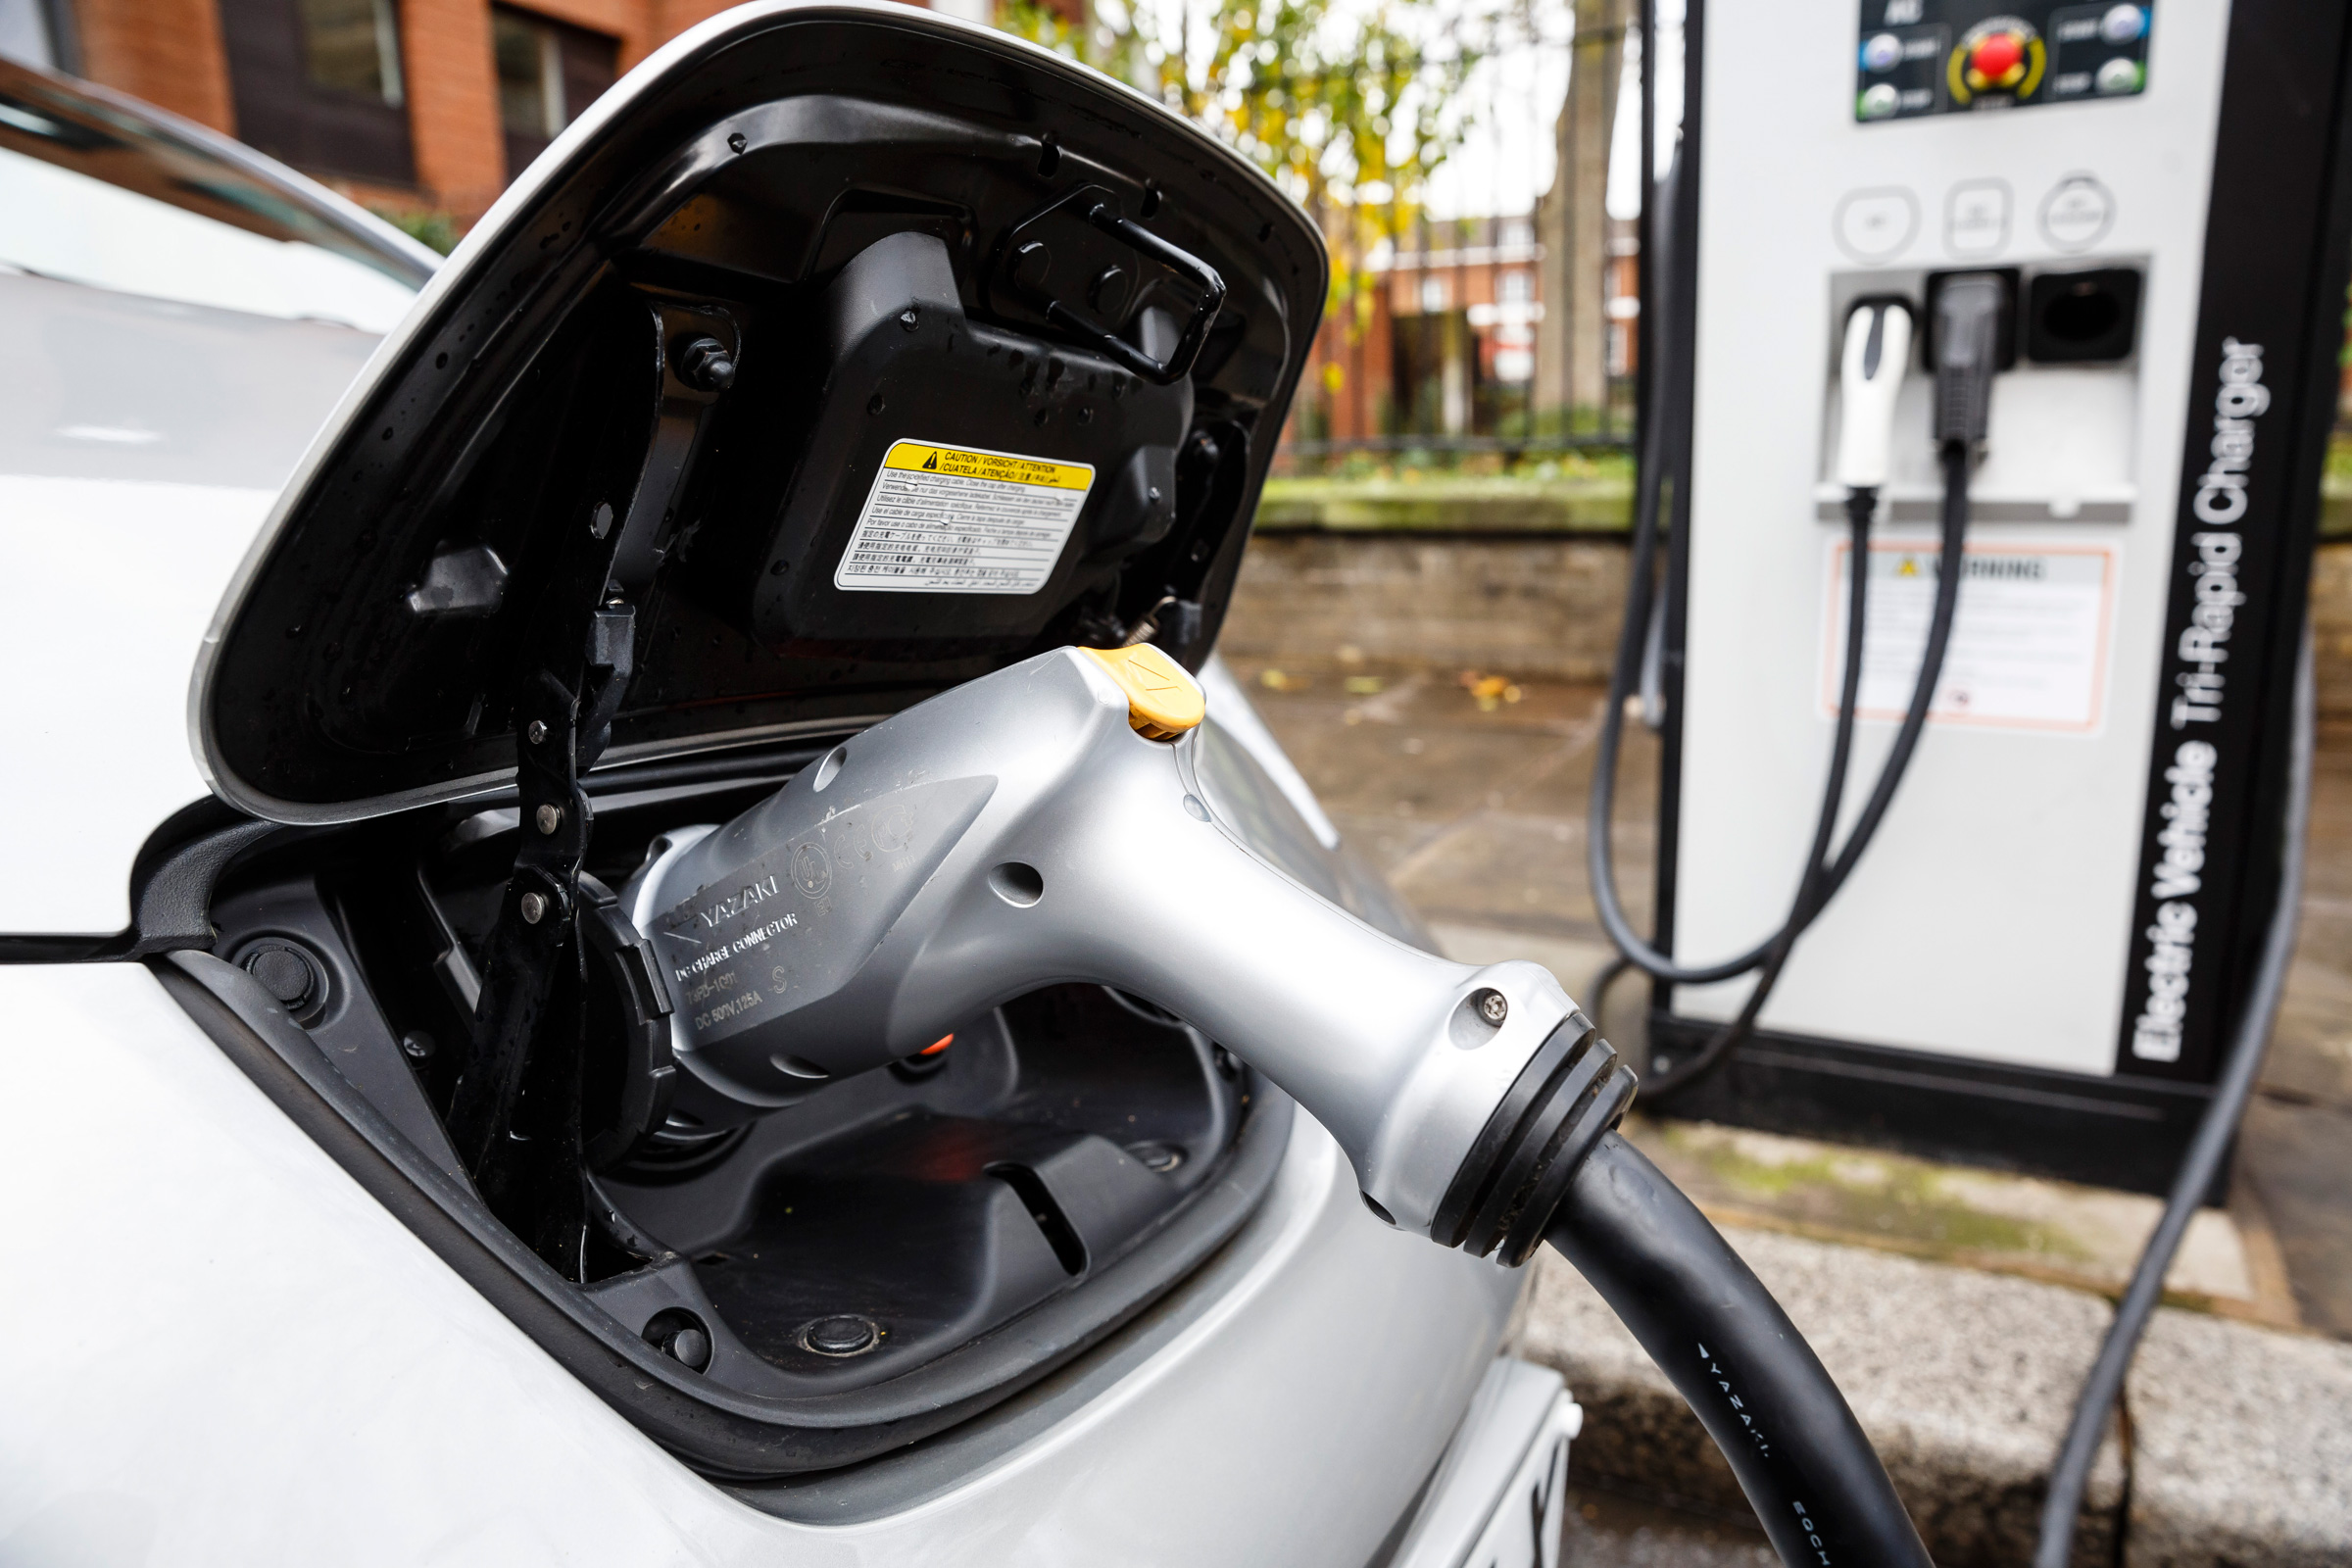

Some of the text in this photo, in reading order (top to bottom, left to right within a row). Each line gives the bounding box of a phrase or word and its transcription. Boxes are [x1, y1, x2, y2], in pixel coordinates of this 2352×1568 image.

[945, 453, 978, 464] CAUTION
[982, 458, 1017, 468] VORSICHT
[1021, 463, 1056, 473] ATTENTION
[2132, 335, 2271, 1062] Electric Vehicle Tri-Rapid Charger
[701, 875, 780, 927] YAZAKI
[692, 945, 732, 974] CHARGE
[733, 912, 798, 955] CONNECTOR
[695, 1012, 712, 1030] DC
